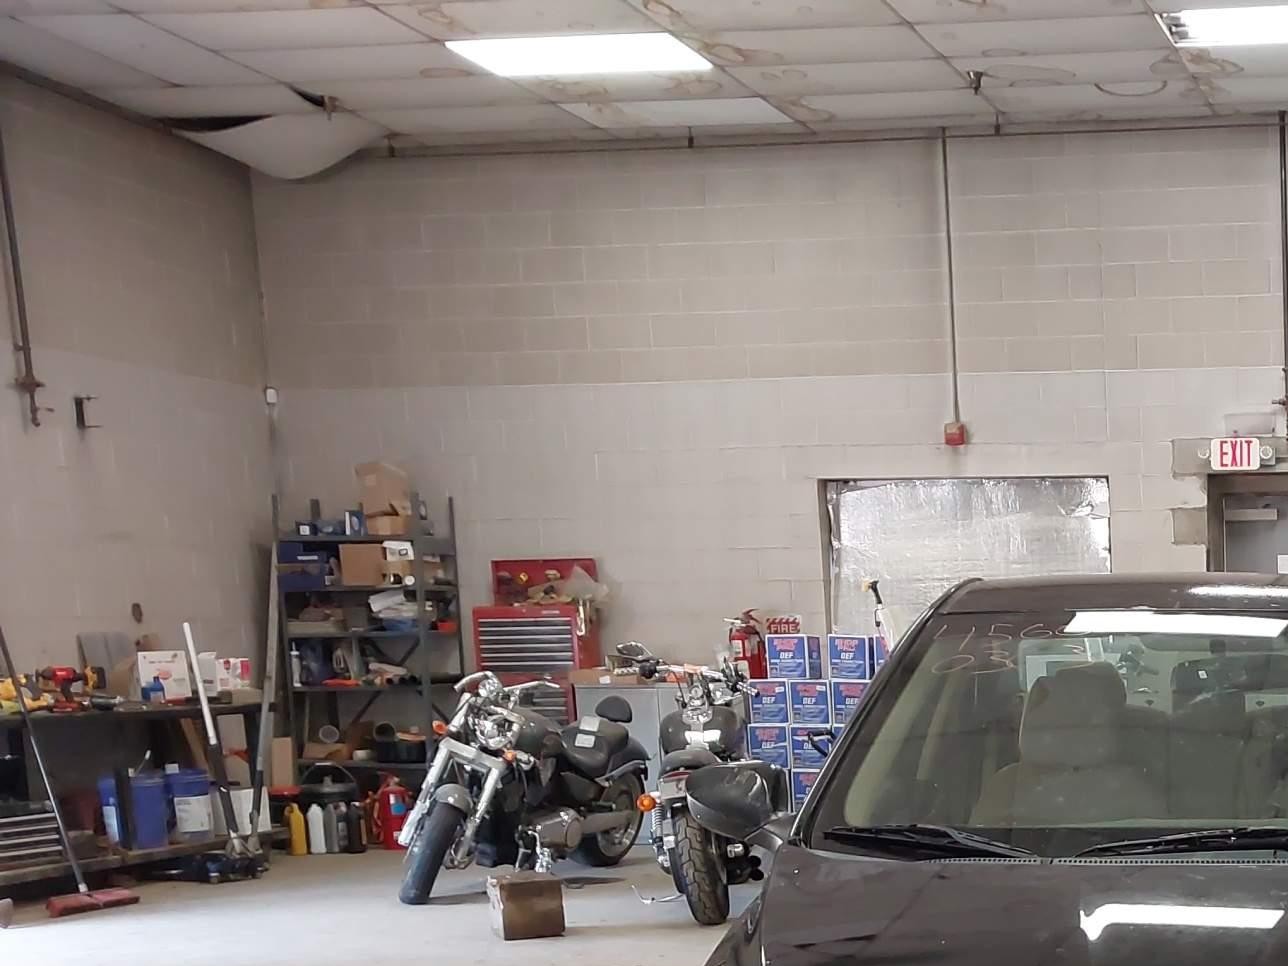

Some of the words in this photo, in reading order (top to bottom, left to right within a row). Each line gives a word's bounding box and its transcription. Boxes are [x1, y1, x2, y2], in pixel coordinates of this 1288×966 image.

[1219, 440, 1253, 468] EXIT
[770, 623, 797, 634] FIRE
[779, 651, 794, 660] DEF
[840, 652, 855, 660] DEF
[762, 696, 776, 704] DEF
[802, 697, 817, 705] DEF
